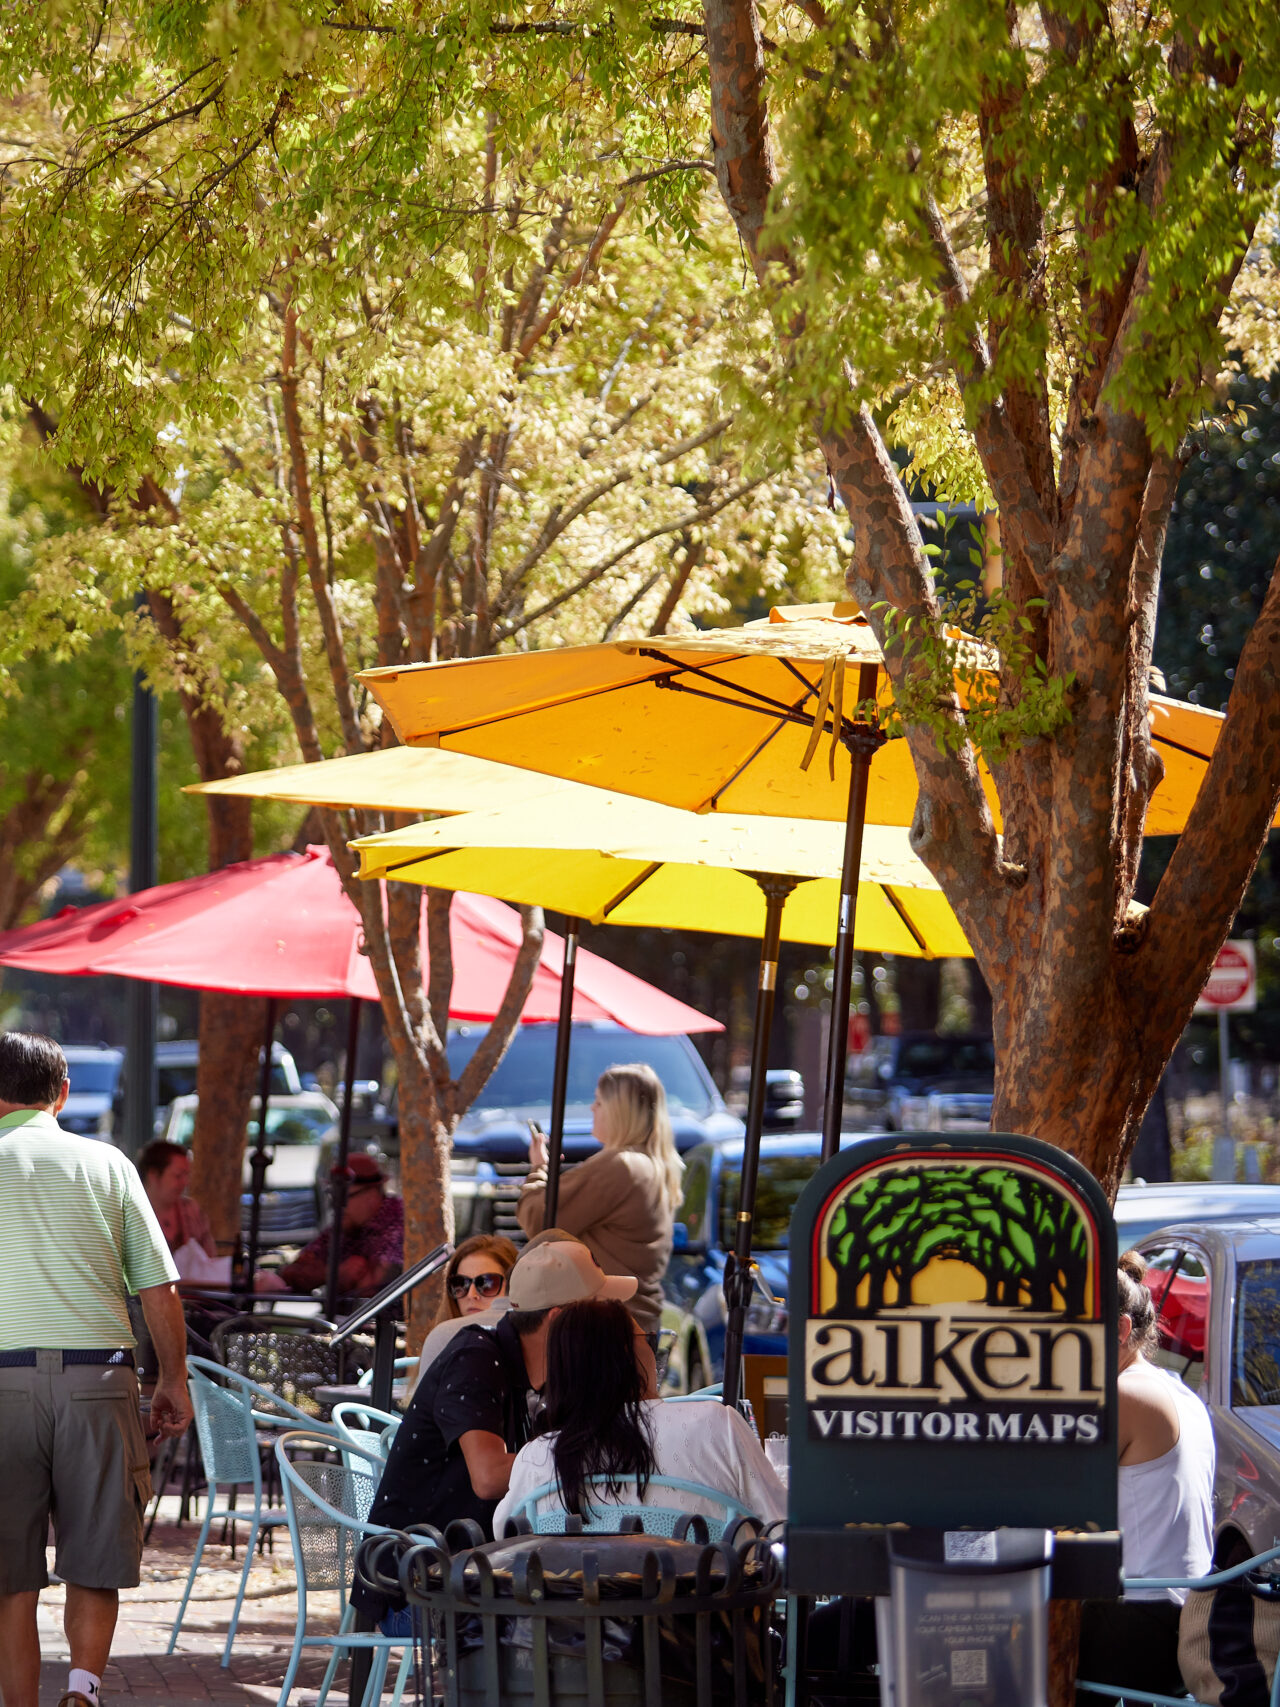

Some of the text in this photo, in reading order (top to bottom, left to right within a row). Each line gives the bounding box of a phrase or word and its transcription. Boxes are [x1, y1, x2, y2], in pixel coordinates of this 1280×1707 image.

[811, 1318, 1102, 1401] aiken
[812, 1410, 1099, 1439] VISITOR MAPS
